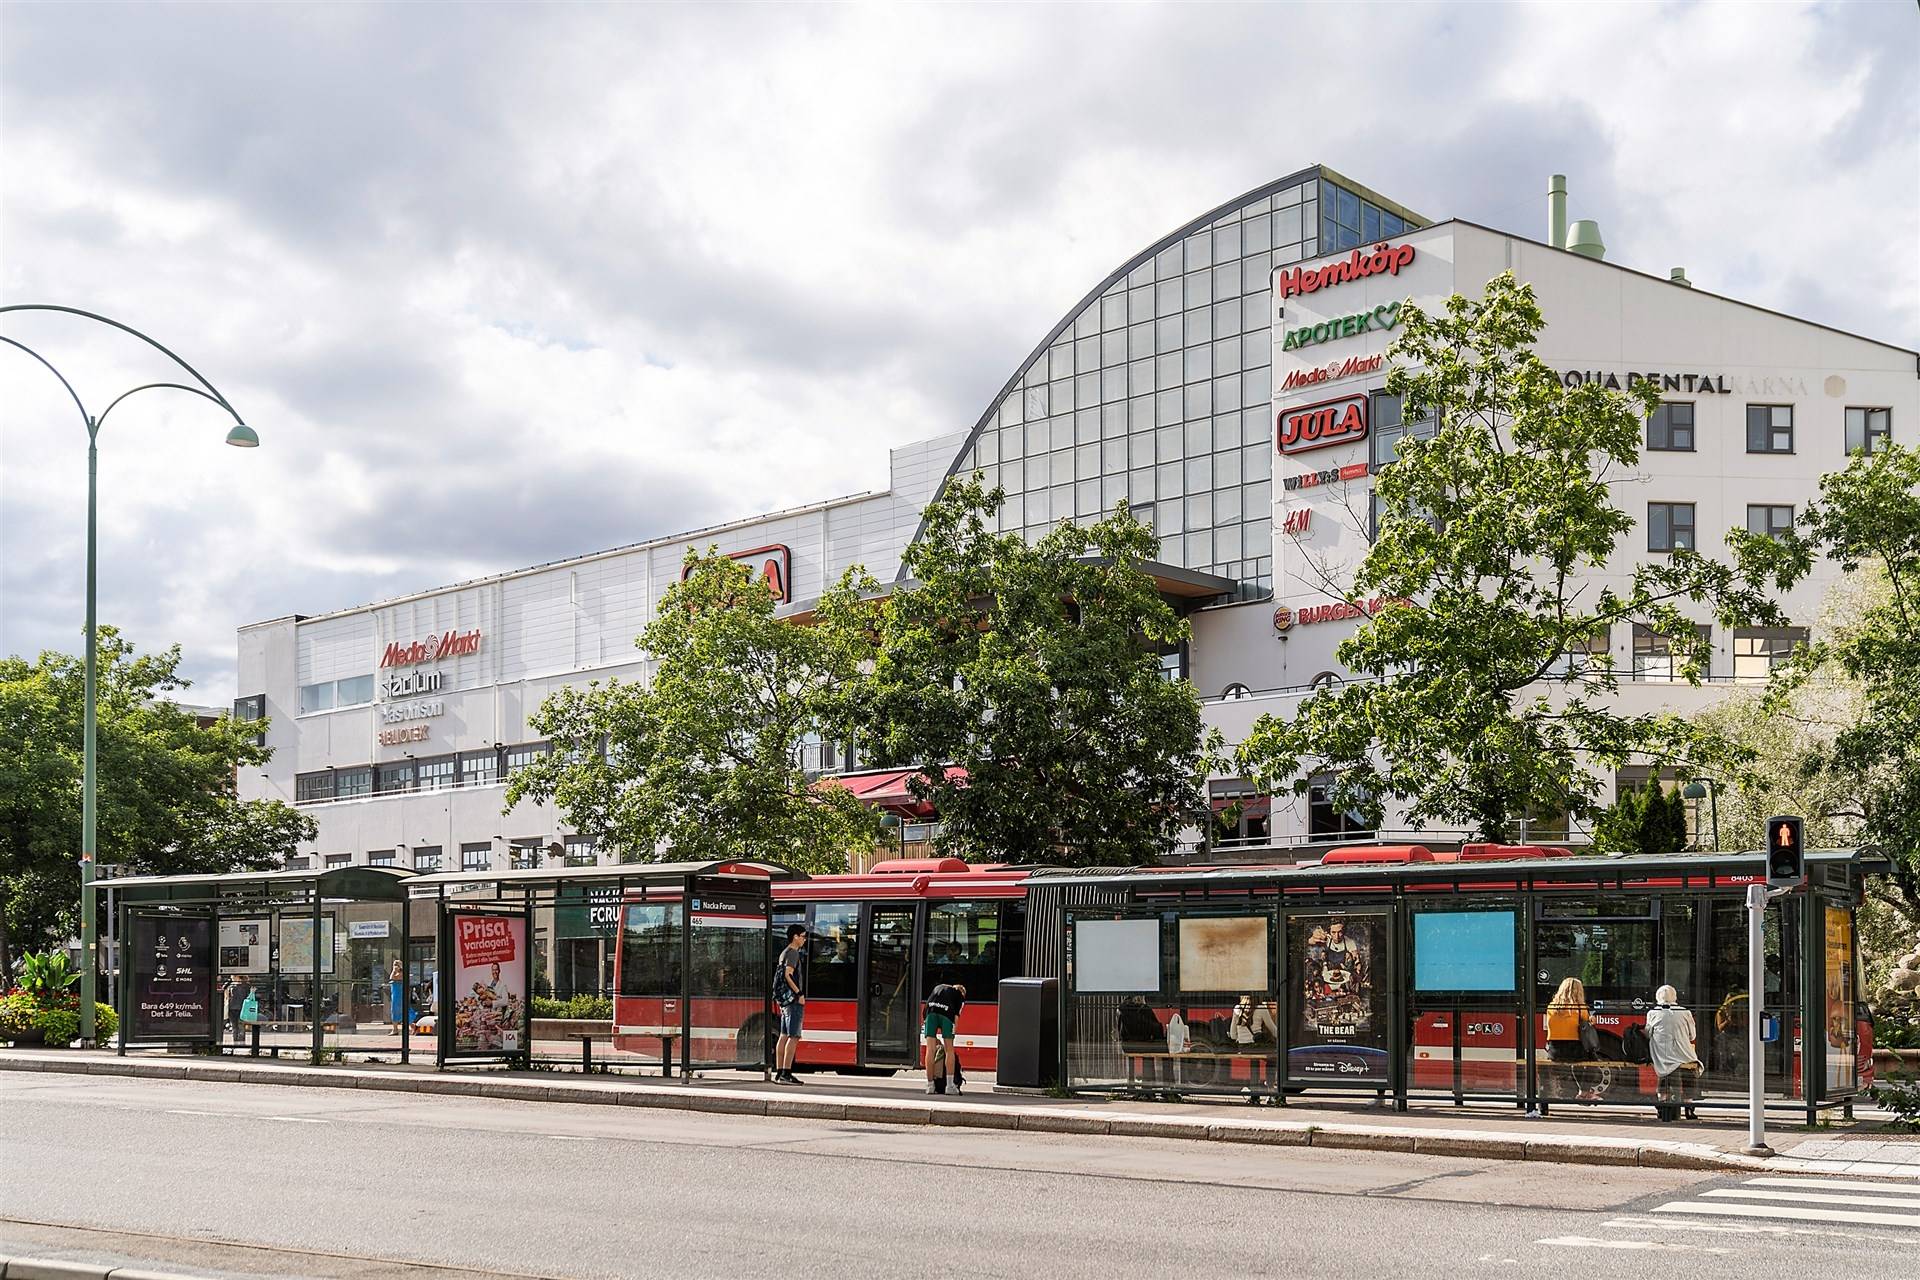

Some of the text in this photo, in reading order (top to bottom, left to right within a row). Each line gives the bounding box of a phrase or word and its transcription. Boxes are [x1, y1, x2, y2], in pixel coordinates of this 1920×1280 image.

[1280, 243, 1415, 299] Hemköp
[1281, 311, 1372, 352] APOTEK
[1628, 371, 1731, 394] DENTAL
[1281, 403, 1363, 445] JULA
[1298, 600, 1365, 625] BURGER
[702, 901, 736, 910] Nacka Forum
[691, 917, 703, 926] 465
[463, 919, 505, 940] Prisa
[464, 936, 509, 950] vardagen!
[141, 1002, 203, 1010] Bara 649 kr/mån.
[151, 1010, 193, 1018] Det är Telia.
[1596, 1014, 1620, 1025] lbuss
[1318, 1025, 1355, 1035] THE BEAR
[505, 1033, 516, 1041] ICA
